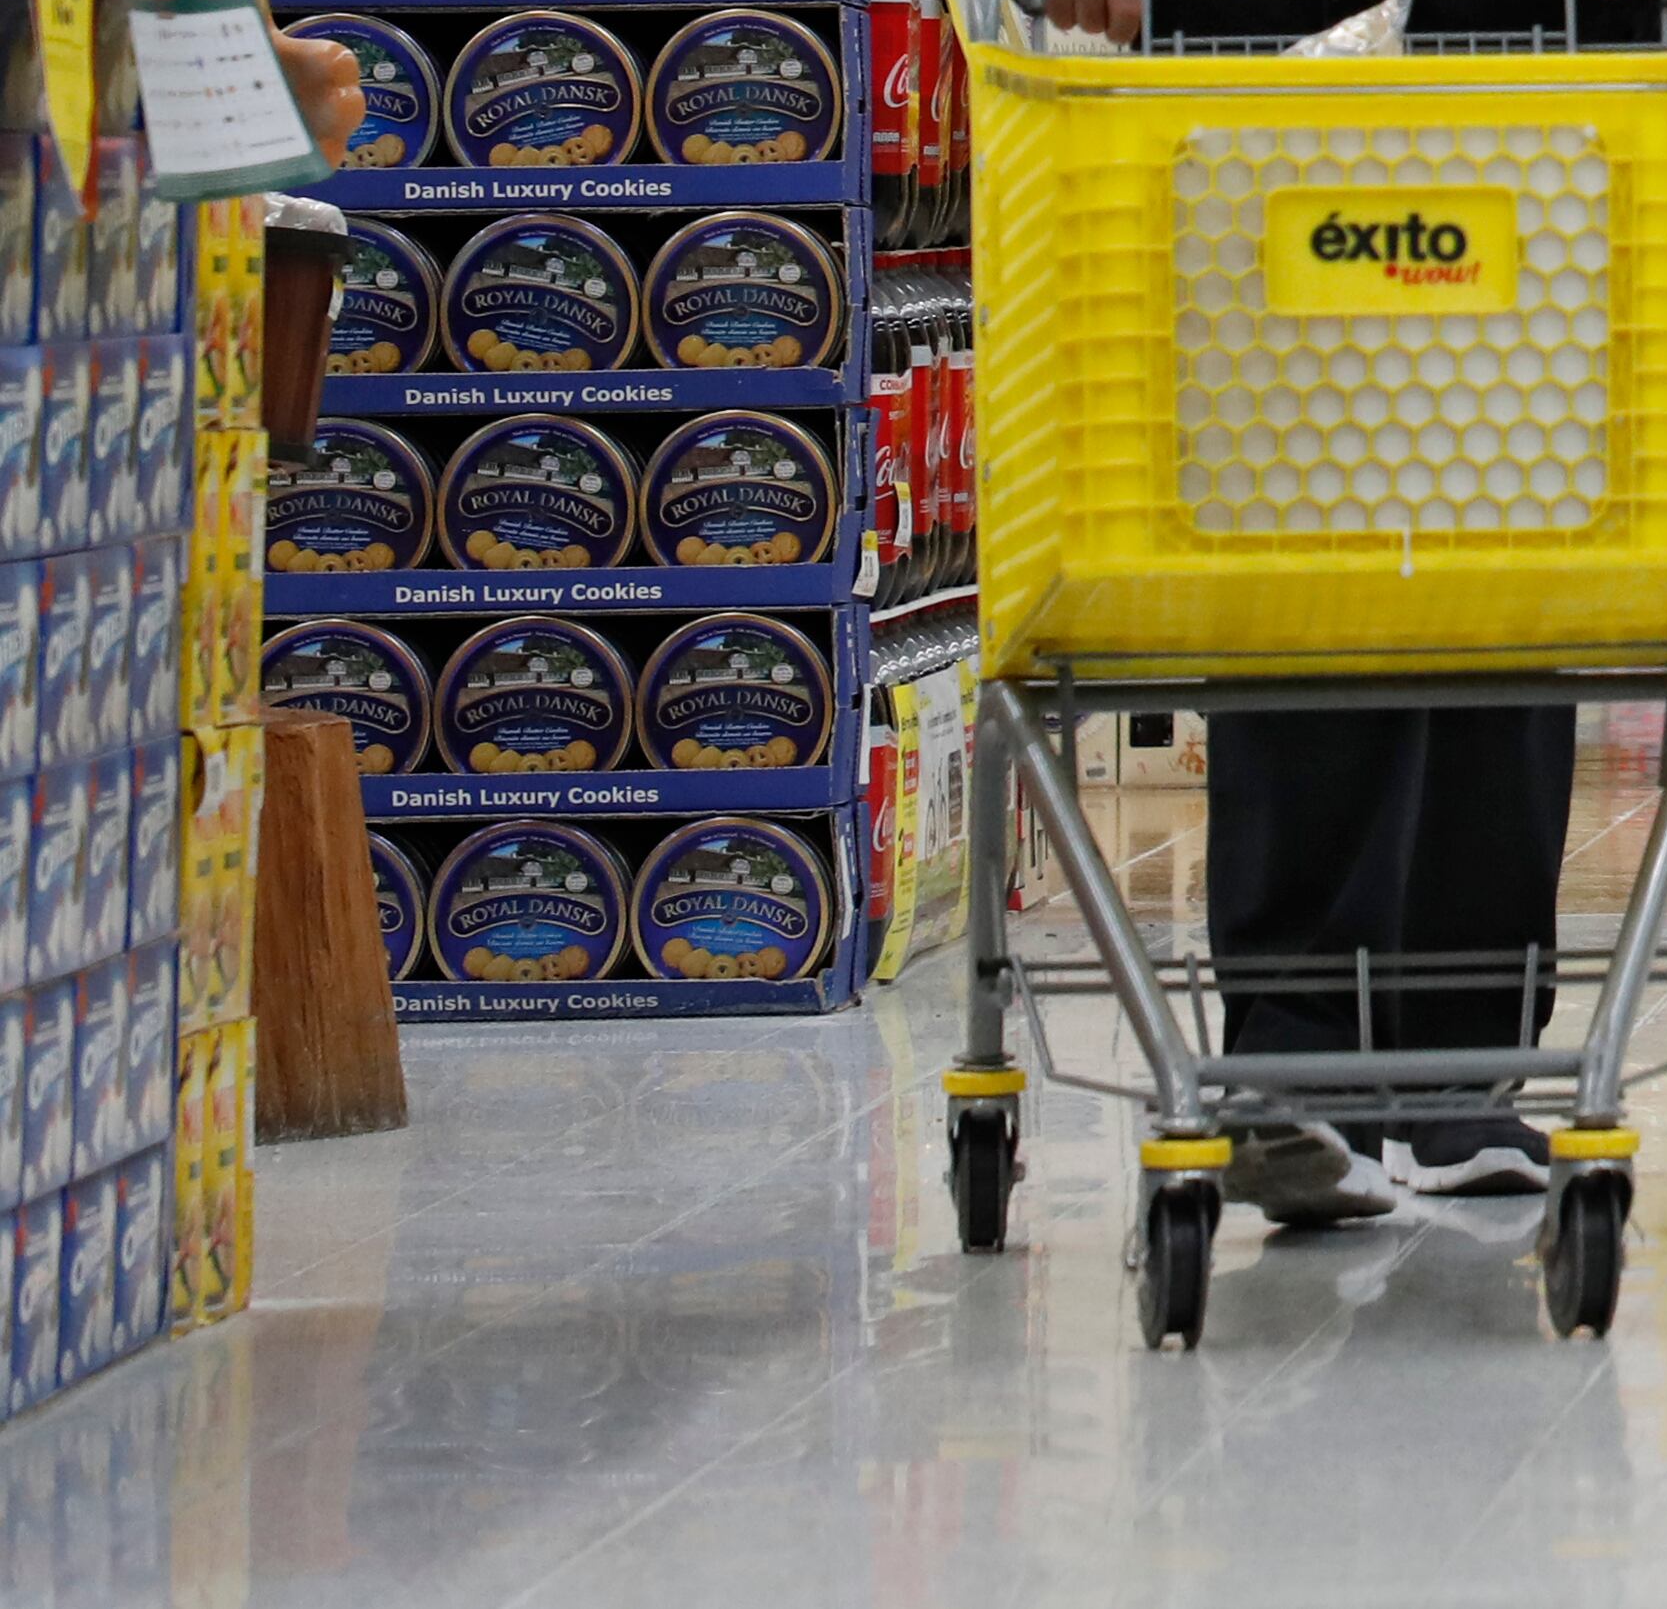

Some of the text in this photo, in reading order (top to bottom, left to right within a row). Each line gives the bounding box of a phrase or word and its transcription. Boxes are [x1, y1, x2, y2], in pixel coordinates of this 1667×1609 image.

[473, 84, 609, 130] ROYAL DANSK
[676, 85, 808, 117] ROYAL DANSK
[405, 178, 671, 201] Danish Luxury Cookies
[1311, 212, 1467, 263] éxito
[1400, 261, 1481, 286] wow!
[405, 384, 672, 406] Danish Luxury Cookies
[671, 487, 805, 520] ROYAL DANSK
[392, 785, 658, 808] Danish Luxury Cookies
[459, 898, 595, 930] ROYAL DANSK
